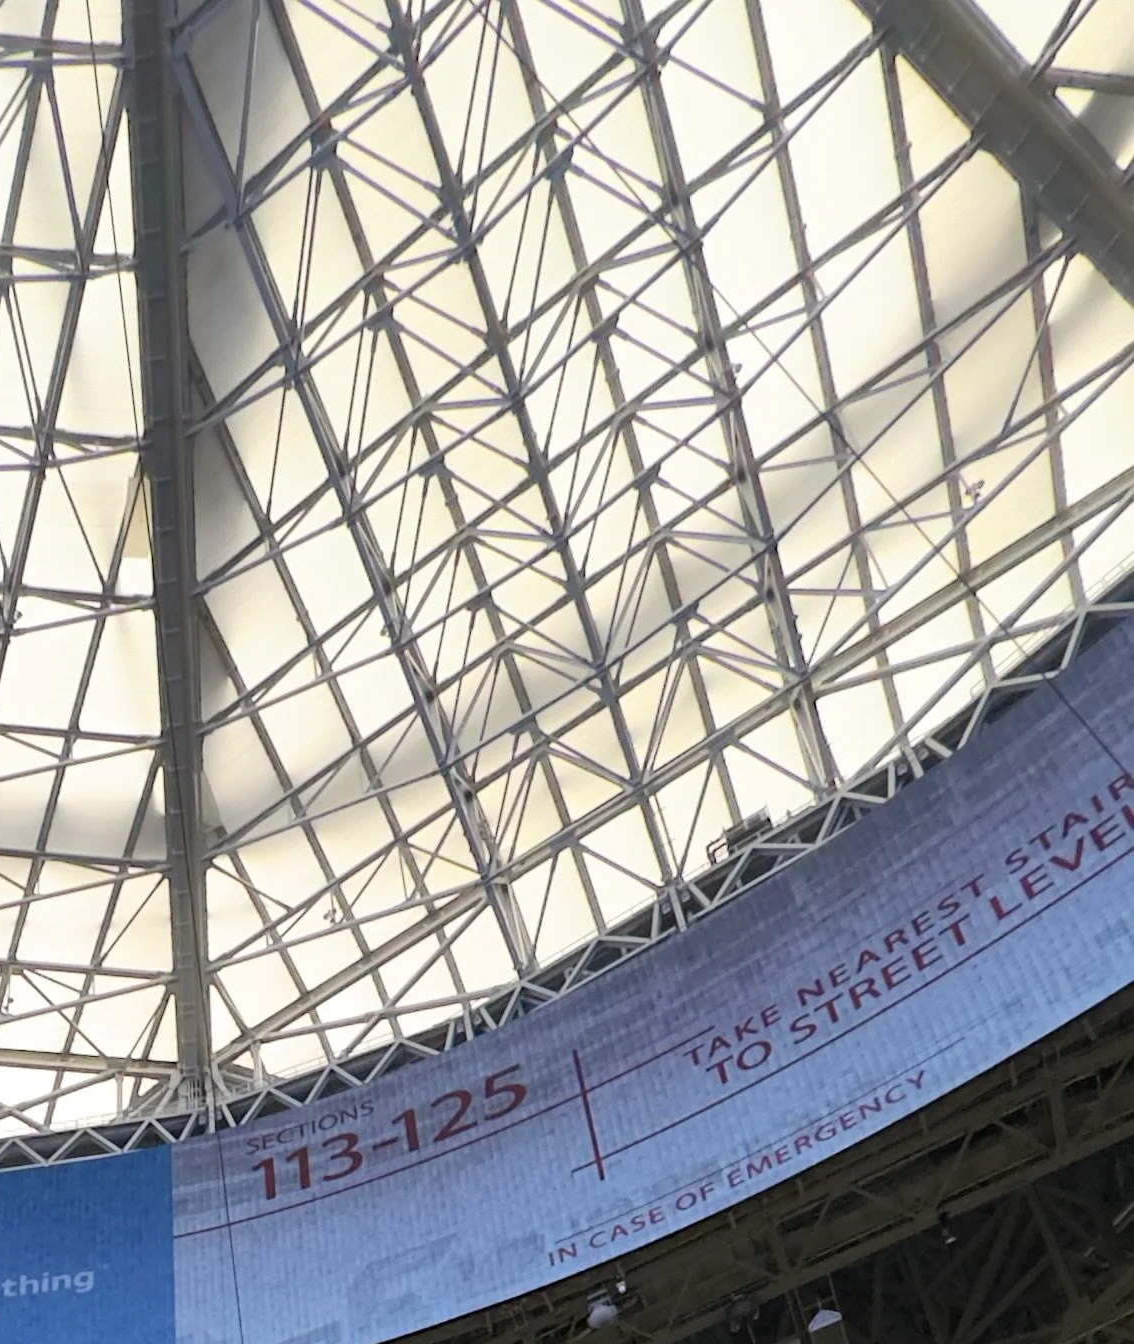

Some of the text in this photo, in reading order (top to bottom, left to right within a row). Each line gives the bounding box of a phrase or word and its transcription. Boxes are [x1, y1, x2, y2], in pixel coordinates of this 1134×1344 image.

[682, 1003, 783, 1065] TAKE
[796, 873, 985, 1006] NEAREST
[706, 1040, 772, 1085] TO
[790, 913, 970, 1044] STREET
[246, 1099, 375, 1154] SECTIONS
[252, 1063, 528, 1200] 113-125
[547, 1069, 927, 1267] IN CASE OF EMERGENCY
